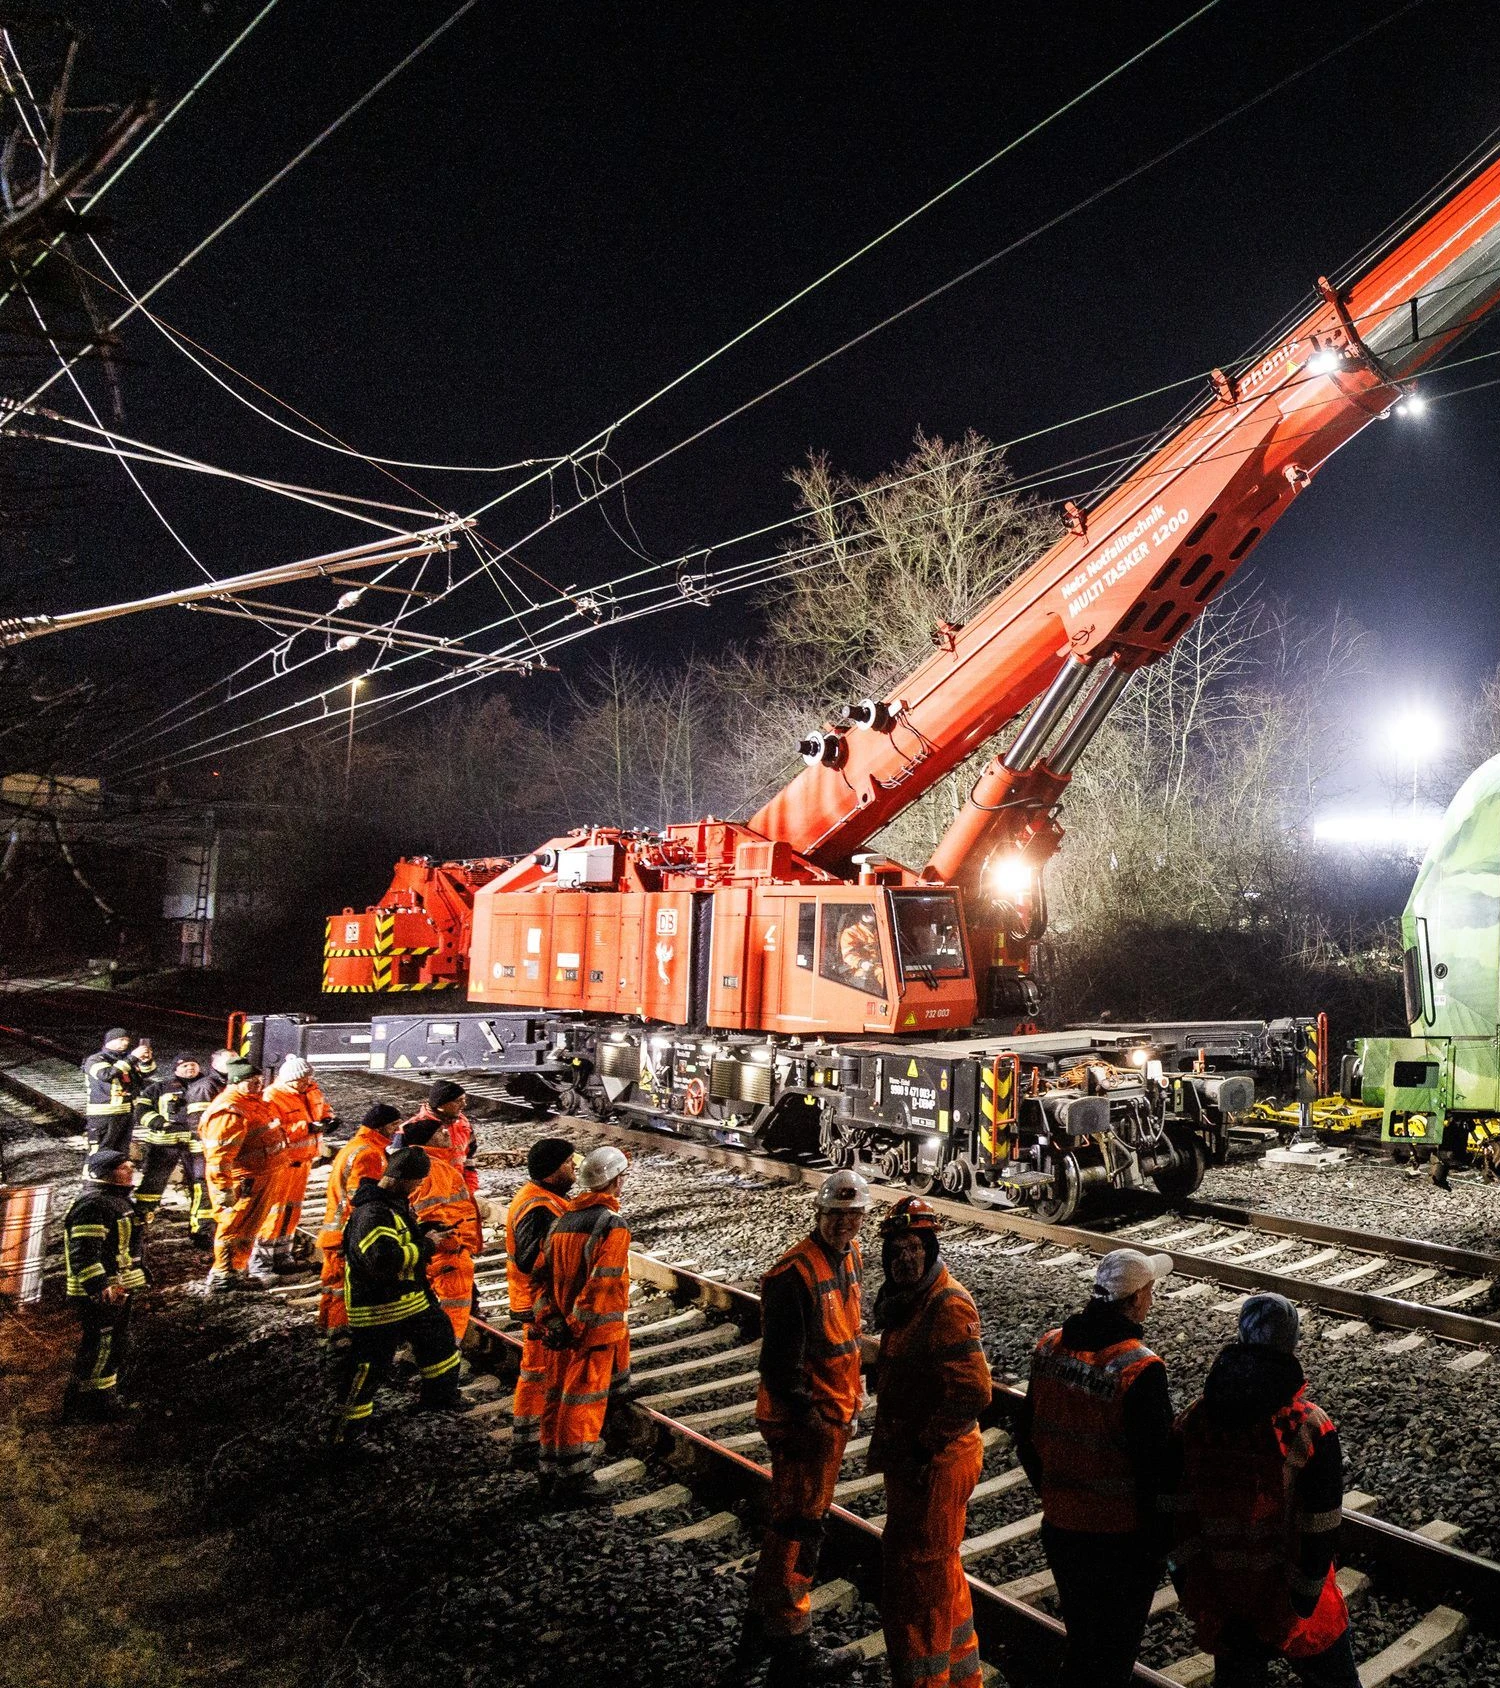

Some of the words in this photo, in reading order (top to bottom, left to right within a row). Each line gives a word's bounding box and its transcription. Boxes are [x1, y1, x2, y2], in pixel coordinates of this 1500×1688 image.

[1241, 337, 1300, 395] Phönix
[1060, 571, 1089, 600] Netz
[1086, 504, 1167, 577] Notfalltechnik
[1067, 579, 1105, 618] MULTI
[1102, 541, 1151, 587] TASKER
[1151, 508, 1189, 548] 1200
[658, 911, 676, 933] DB
